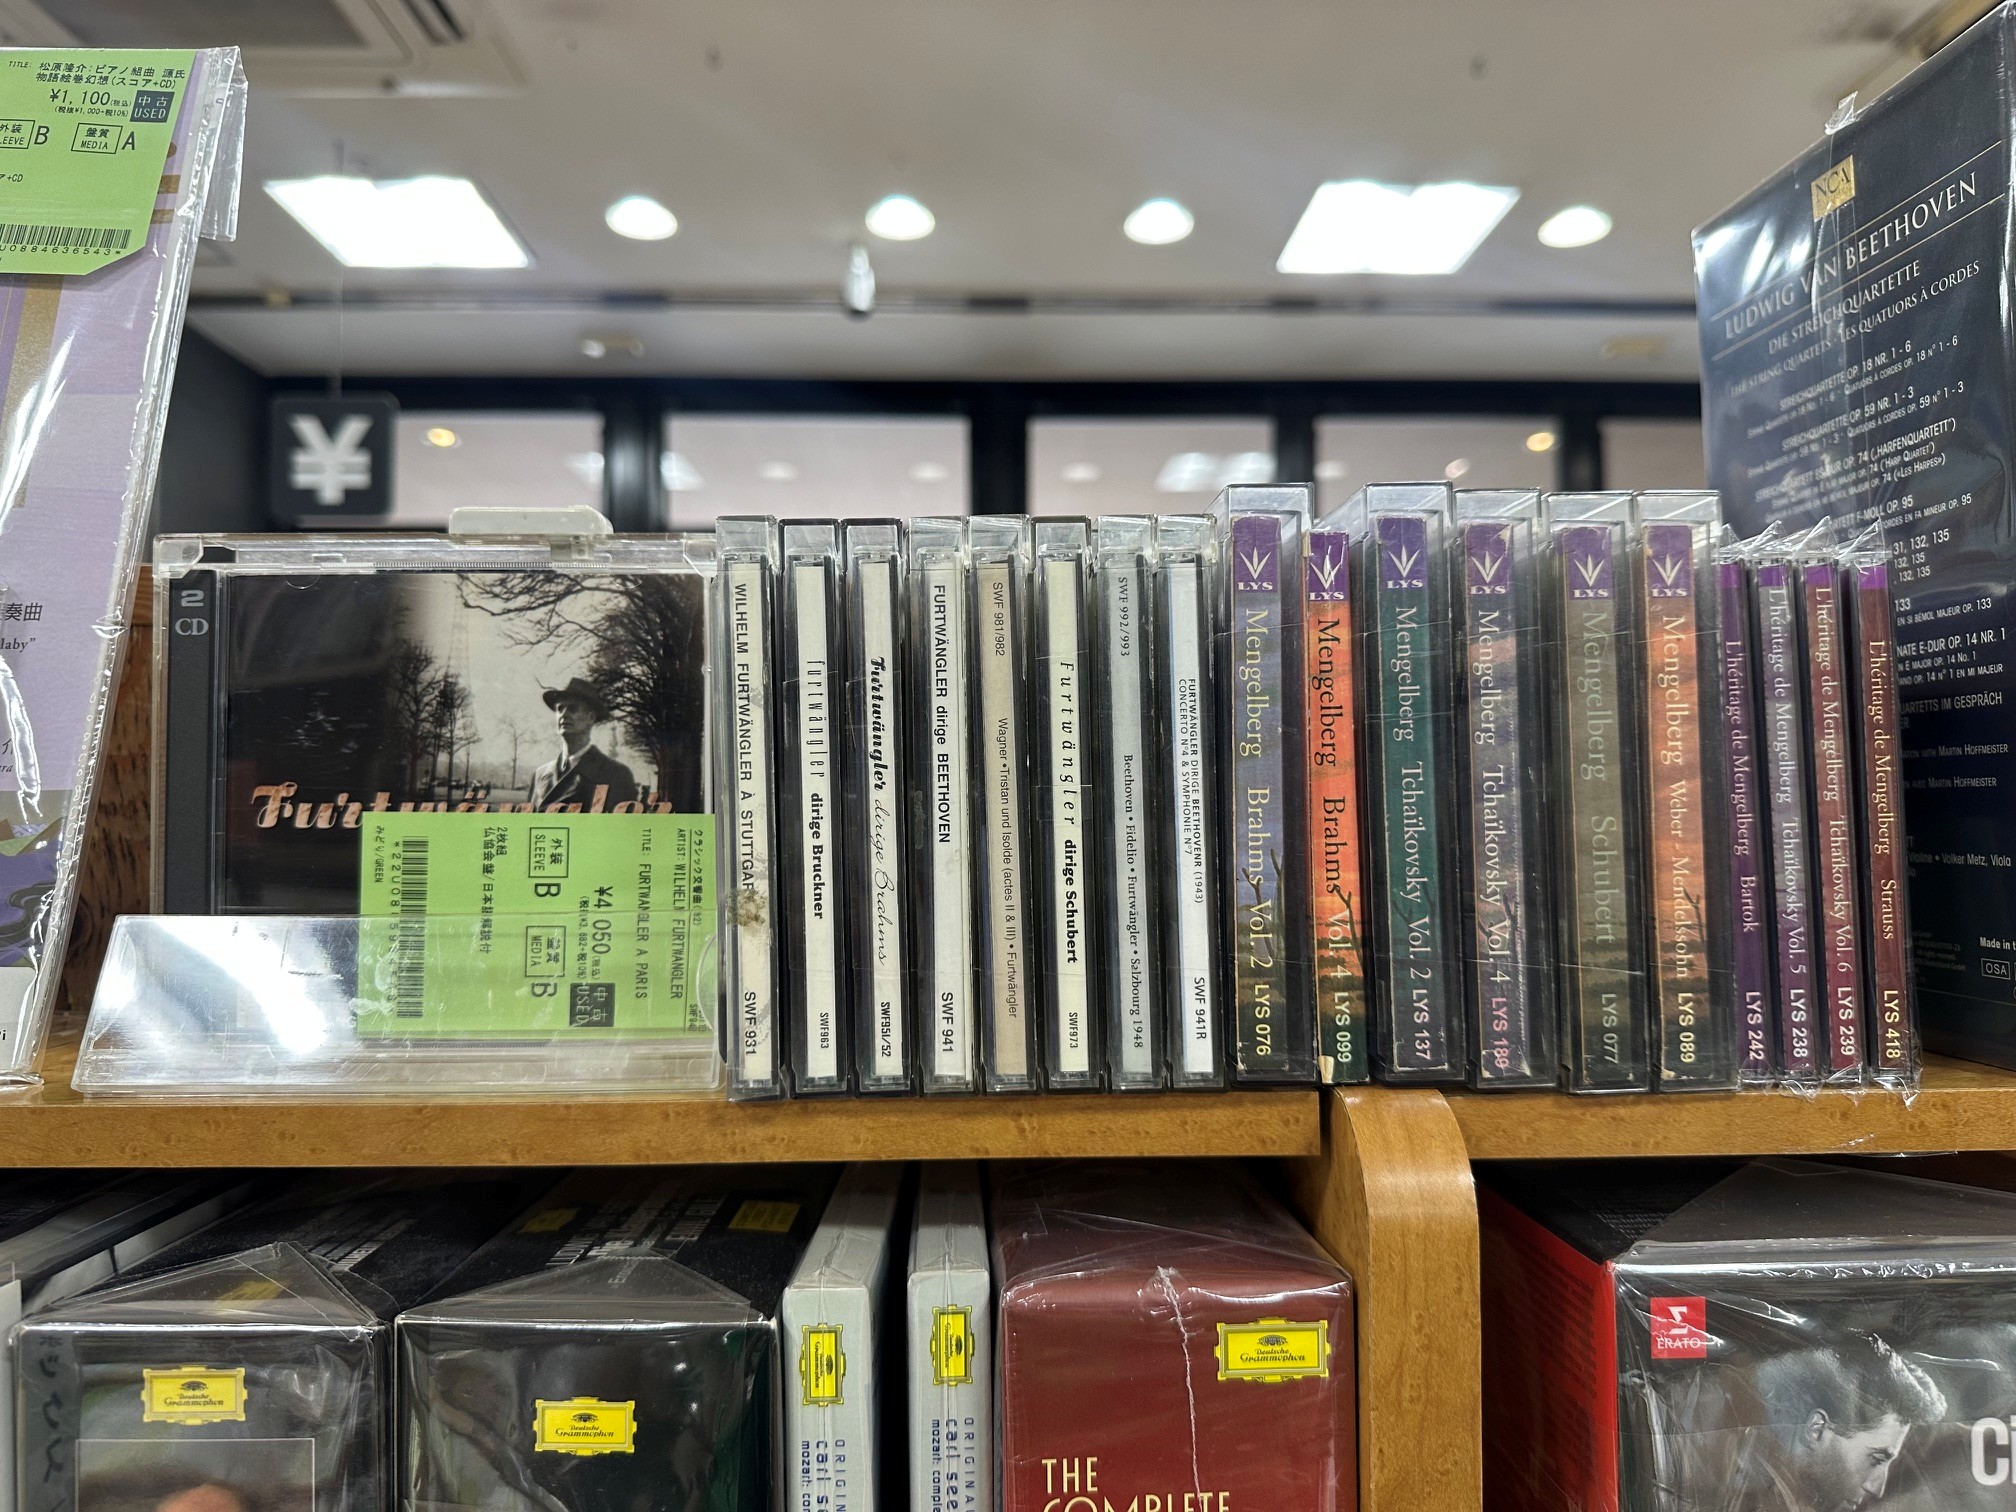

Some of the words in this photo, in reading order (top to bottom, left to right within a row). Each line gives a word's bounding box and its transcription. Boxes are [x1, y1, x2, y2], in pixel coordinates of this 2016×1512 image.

[8, 60, 32, 68] TITLE:
[163, 68, 186, 79] 源氏
[134, 108, 166, 119] USED
[138, 94, 168, 106] 中古
[0, 136, 25, 146] EEVE
[34, 126, 50, 146] B
[80, 140, 108, 150] MEDIA
[85, 127, 110, 138] 盤質
[121, 131, 136, 150] A
[1723, 284, 1796, 341] LUDWIG
[1800, 256, 1840, 293] VAN
[1845, 172, 1978, 271] BEETHOVEN
[1768, 330, 1792, 355] DIE
[1791, 260, 1921, 345] STREICHQUARTETTE
[1858, 292, 1918, 334] QUATUORS
[1930, 260, 1980, 296] CORDES
[1862, 358, 1873, 373] 18
[1874, 353, 1890, 368] NR.
[1877, 397, 1892, 412] NR.
[1902, 494, 1914, 509] 95
[1923, 503, 1946, 518] MINEUR
[1961, 493, 1972, 506] 95
[1932, 528, 1950, 544] 135
[1912, 552, 1926, 564] 135
[1916, 566, 1931, 578] 135
[0, 602, 44, 622] 奏曲
[181, 589, 204, 607] 2
[992, 582, 1004, 609] SWF
[1894, 598, 1911, 612] 133
[1936, 606, 1961, 620] MAJEUR
[1976, 597, 1992, 610] 133
[174, 618, 209, 636] CD
[734, 583, 748, 654] WILHELM
[994, 612, 1006, 656] 981/982
[1119, 604, 1131, 657] 992/993
[934, 584, 950, 698] FURTWÄNGLER
[1918, 636, 1946, 654] E-DUR
[1948, 635, 1962, 648] OP.
[1965, 632, 1978, 646] 14
[1980, 629, 1997, 644] NR.
[1239, 608, 1270, 758] Mengelberg
[1390, 606, 1420, 742] Mengelberg
[1472, 610, 1502, 746] Mengelberg
[1657, 614, 1690, 766] Mengelberg
[1926, 670, 1936, 682] 14
[1977, 663, 2003, 674] MAJEUR
[1178, 678, 1188, 735] CONCERTO
[1312, 618, 1344, 767] Mengelberg
[1576, 612, 1614, 782] Mengelberg
[1954, 692, 2002, 708] GESPRÄCH
[737, 663, 754, 781] FURTWÄNGLER
[806, 660, 828, 778] furtwängler
[868, 656, 889, 792] Furtwängler
[934, 705, 949, 746] dirige
[1188, 678, 1198, 756] FURTWÄNGLER
[996, 718, 1008, 761] Wagner
[1059, 662, 1078, 825] Furtwängler
[1773, 702, 1798, 803] Mengelberg
[1820, 700, 1844, 802] Mengelberg
[1964, 744, 2009, 755] HOFFMEISTER
[1124, 754, 1135, 814] Beethoven
[1190, 760, 1200, 796] DIRIGE
[1953, 776, 1997, 788] HOFFMEISTER
[937, 753, 951, 844] BEETHOVEN
[1182, 772, 1192, 834] SYMPHONIE
[1668, 780, 1688, 838] Weber
[1872, 754, 1898, 856] Mengelberg
[496, 826, 508, 856] 2枚組
[642, 828, 652, 856] TITLE:
[1126, 824, 1137, 865] Fidelio
[1247, 786, 1272, 887] Brahms
[1322, 796, 1348, 894] Brahms
[1400, 760, 1426, 902] Tchaïkovsky
[1480, 764, 1508, 906] Tchaïkovsky
[534, 834, 546, 872] SLEEVE
[550, 838, 564, 866] 外装
[1062, 838, 1077, 886] dirige
[1966, 853, 1988, 866] Metz,
[1990, 854, 2012, 867] Viola
[534, 882, 562, 898] B
[812, 844, 826, 920] Bruckner
[1590, 815, 1620, 944] Schubert
[1731, 754, 1754, 856] Mengelberg
[1745, 990, 1761, 1025] LYS
[592, 886, 614, 956] ¥4050
[637, 863, 652, 943] FURTWANGLER
[874, 866, 895, 966] Brahms
[1126, 876, 1140, 947] Furtwängler
[1671, 856, 1691, 978] Mendelssohn
[1880, 879, 1897, 940] Strauss
[1065, 890, 1080, 964] Schubert
[1980, 936, 2000, 949] Made
[530, 935, 542, 968] MEDIA
[636, 948, 648, 957] A
[670, 918, 686, 1000] FURTWANGLER
[1985, 962, 2007, 976] OSA
[530, 982, 558, 998] B
[635, 962, 648, 1000] PARIS
[1006, 952, 1018, 1018] Furtwängler
[1130, 958, 1142, 1016] Salzbourg
[576, 982, 590, 1027] USED
[592, 986, 609, 1023] 中古
[744, 991, 757, 1026] SWF
[941, 992, 954, 1024] SWF
[1254, 984, 1270, 1018] LYS
[1334, 992, 1350, 1026] LYS
[1412, 990, 1428, 1024] LYS
[1491, 997, 1508, 1032] LYS
[1600, 994, 1618, 1028] LYS
[1676, 992, 1694, 1026] LYS
[1790, 988, 1806, 1022] LYS
[1838, 986, 1854, 1020] LYS
[1883, 990, 1900, 1023] LYS
[1068, 1012, 1079, 1049] SWF973
[1132, 1020, 1144, 1048] 1948
[1255, 1024, 1272, 1056] 076
[1678, 1030, 1696, 1063] 089
[1792, 1028, 1808, 1058] 238
[1840, 1025, 1856, 1056] 239
[1886, 1028, 1901, 1059] 418
[1240, 1352, 1306, 1363] Grammophon
[1254, 1347, 1290, 1356] Deutsche
[1656, 1336, 1701, 1350] ERATO
[555, 1428, 614, 1438] Grammophon
[932, 1418, 942, 1466] mozart:
[946, 1418, 961, 1458] carl
[802, 1440, 812, 1488] mozart:
[816, 1440, 832, 1481] carl
[964, 1418, 976, 1512] ORIGINA
[1042, 1456, 1099, 1494] THE
